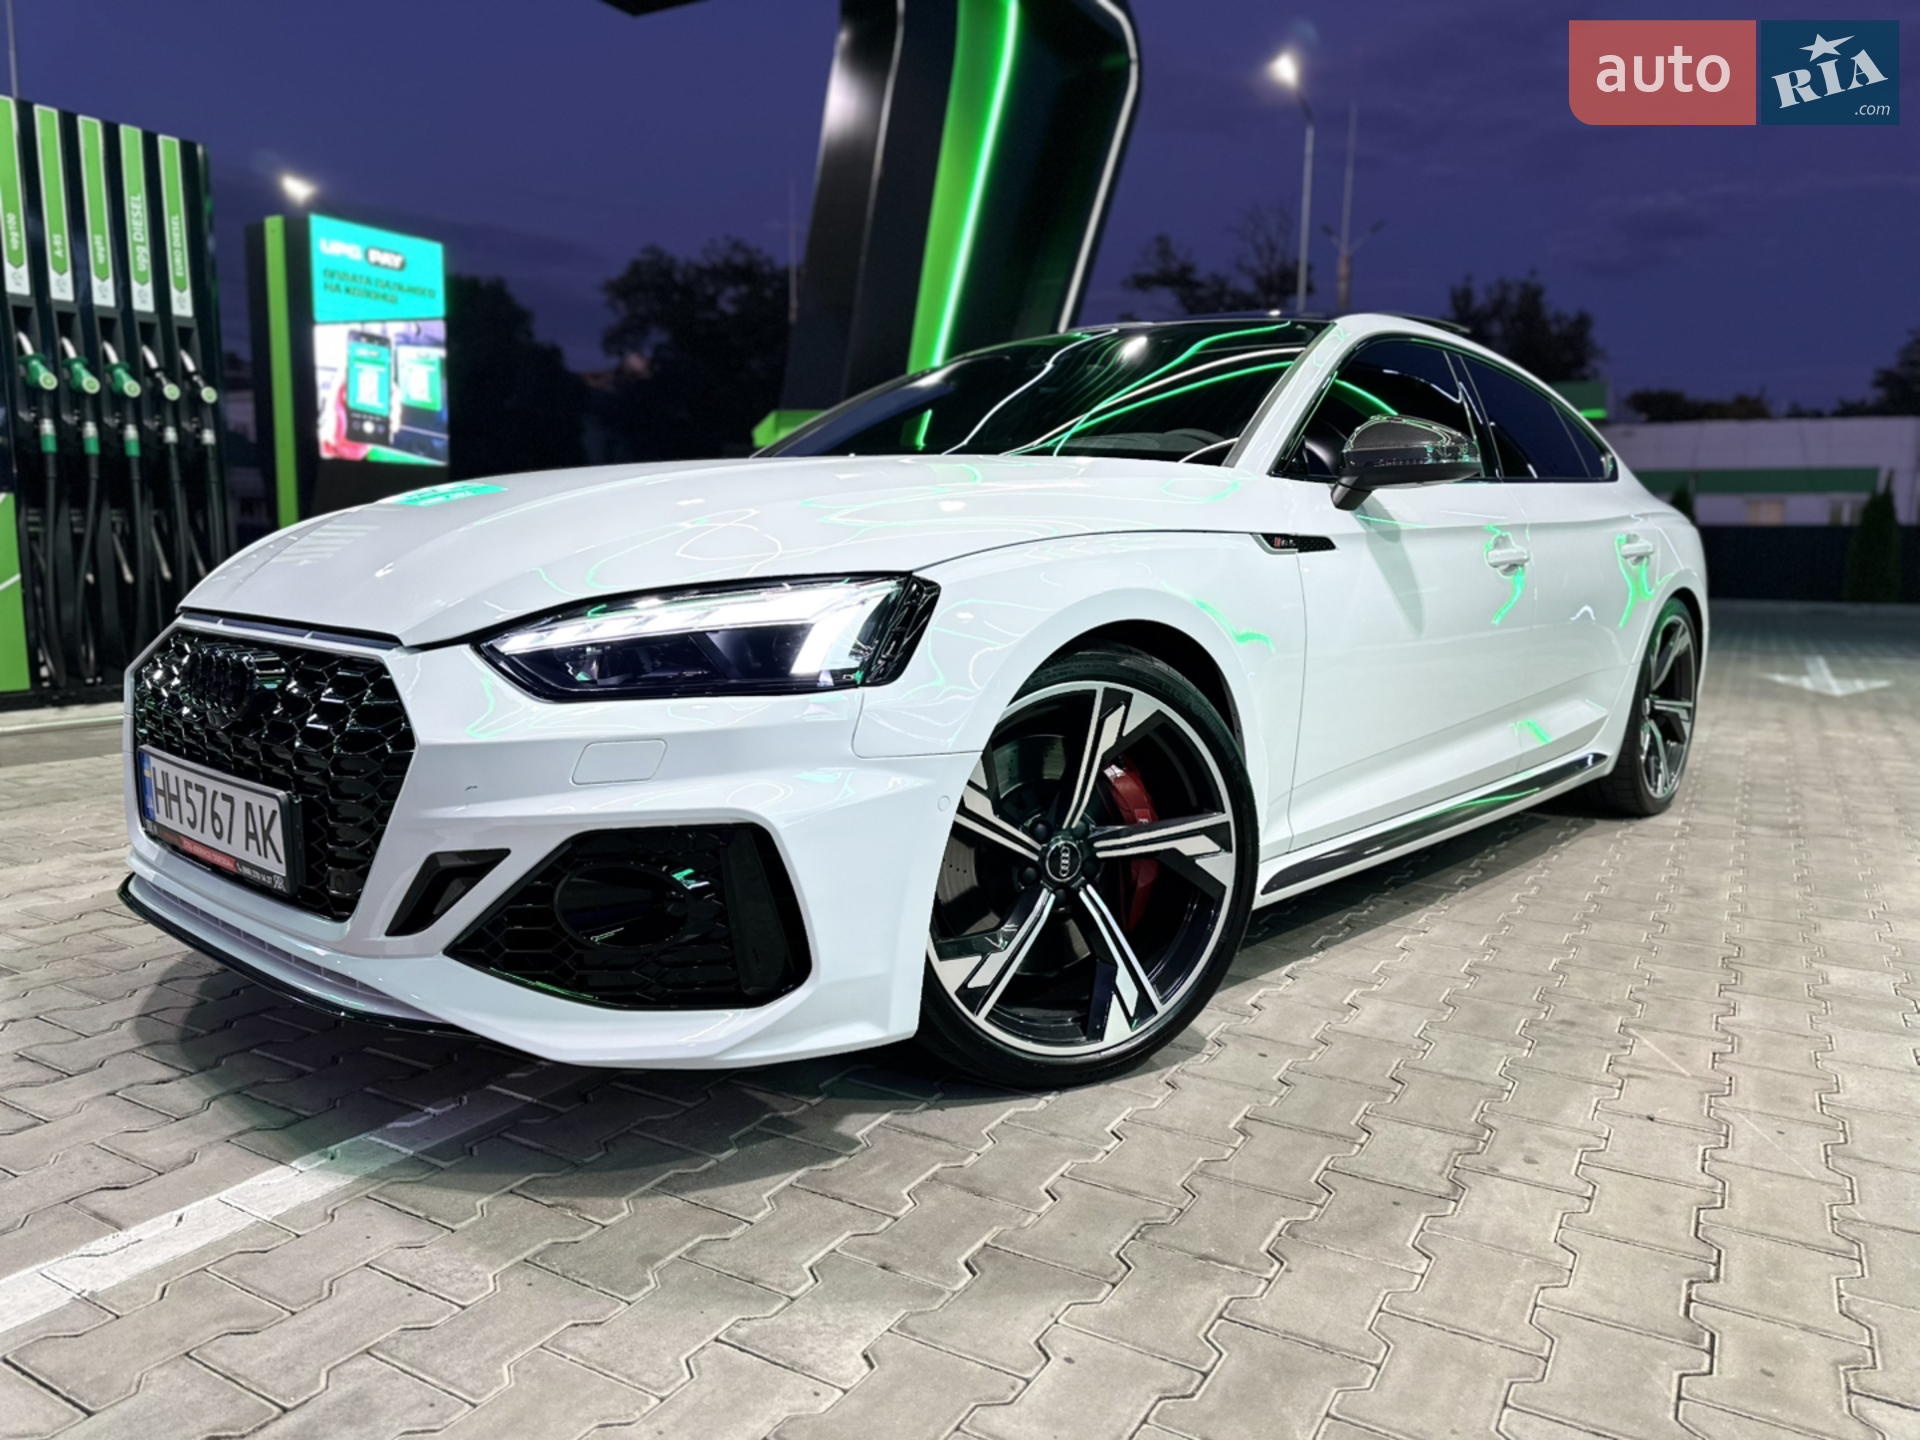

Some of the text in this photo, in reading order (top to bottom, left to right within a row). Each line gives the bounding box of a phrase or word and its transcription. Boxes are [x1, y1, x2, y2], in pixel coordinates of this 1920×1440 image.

[130, 193, 145, 243] DIESEL
[171, 215, 181, 248] DIESEL
[245, 801, 282, 864] AK
